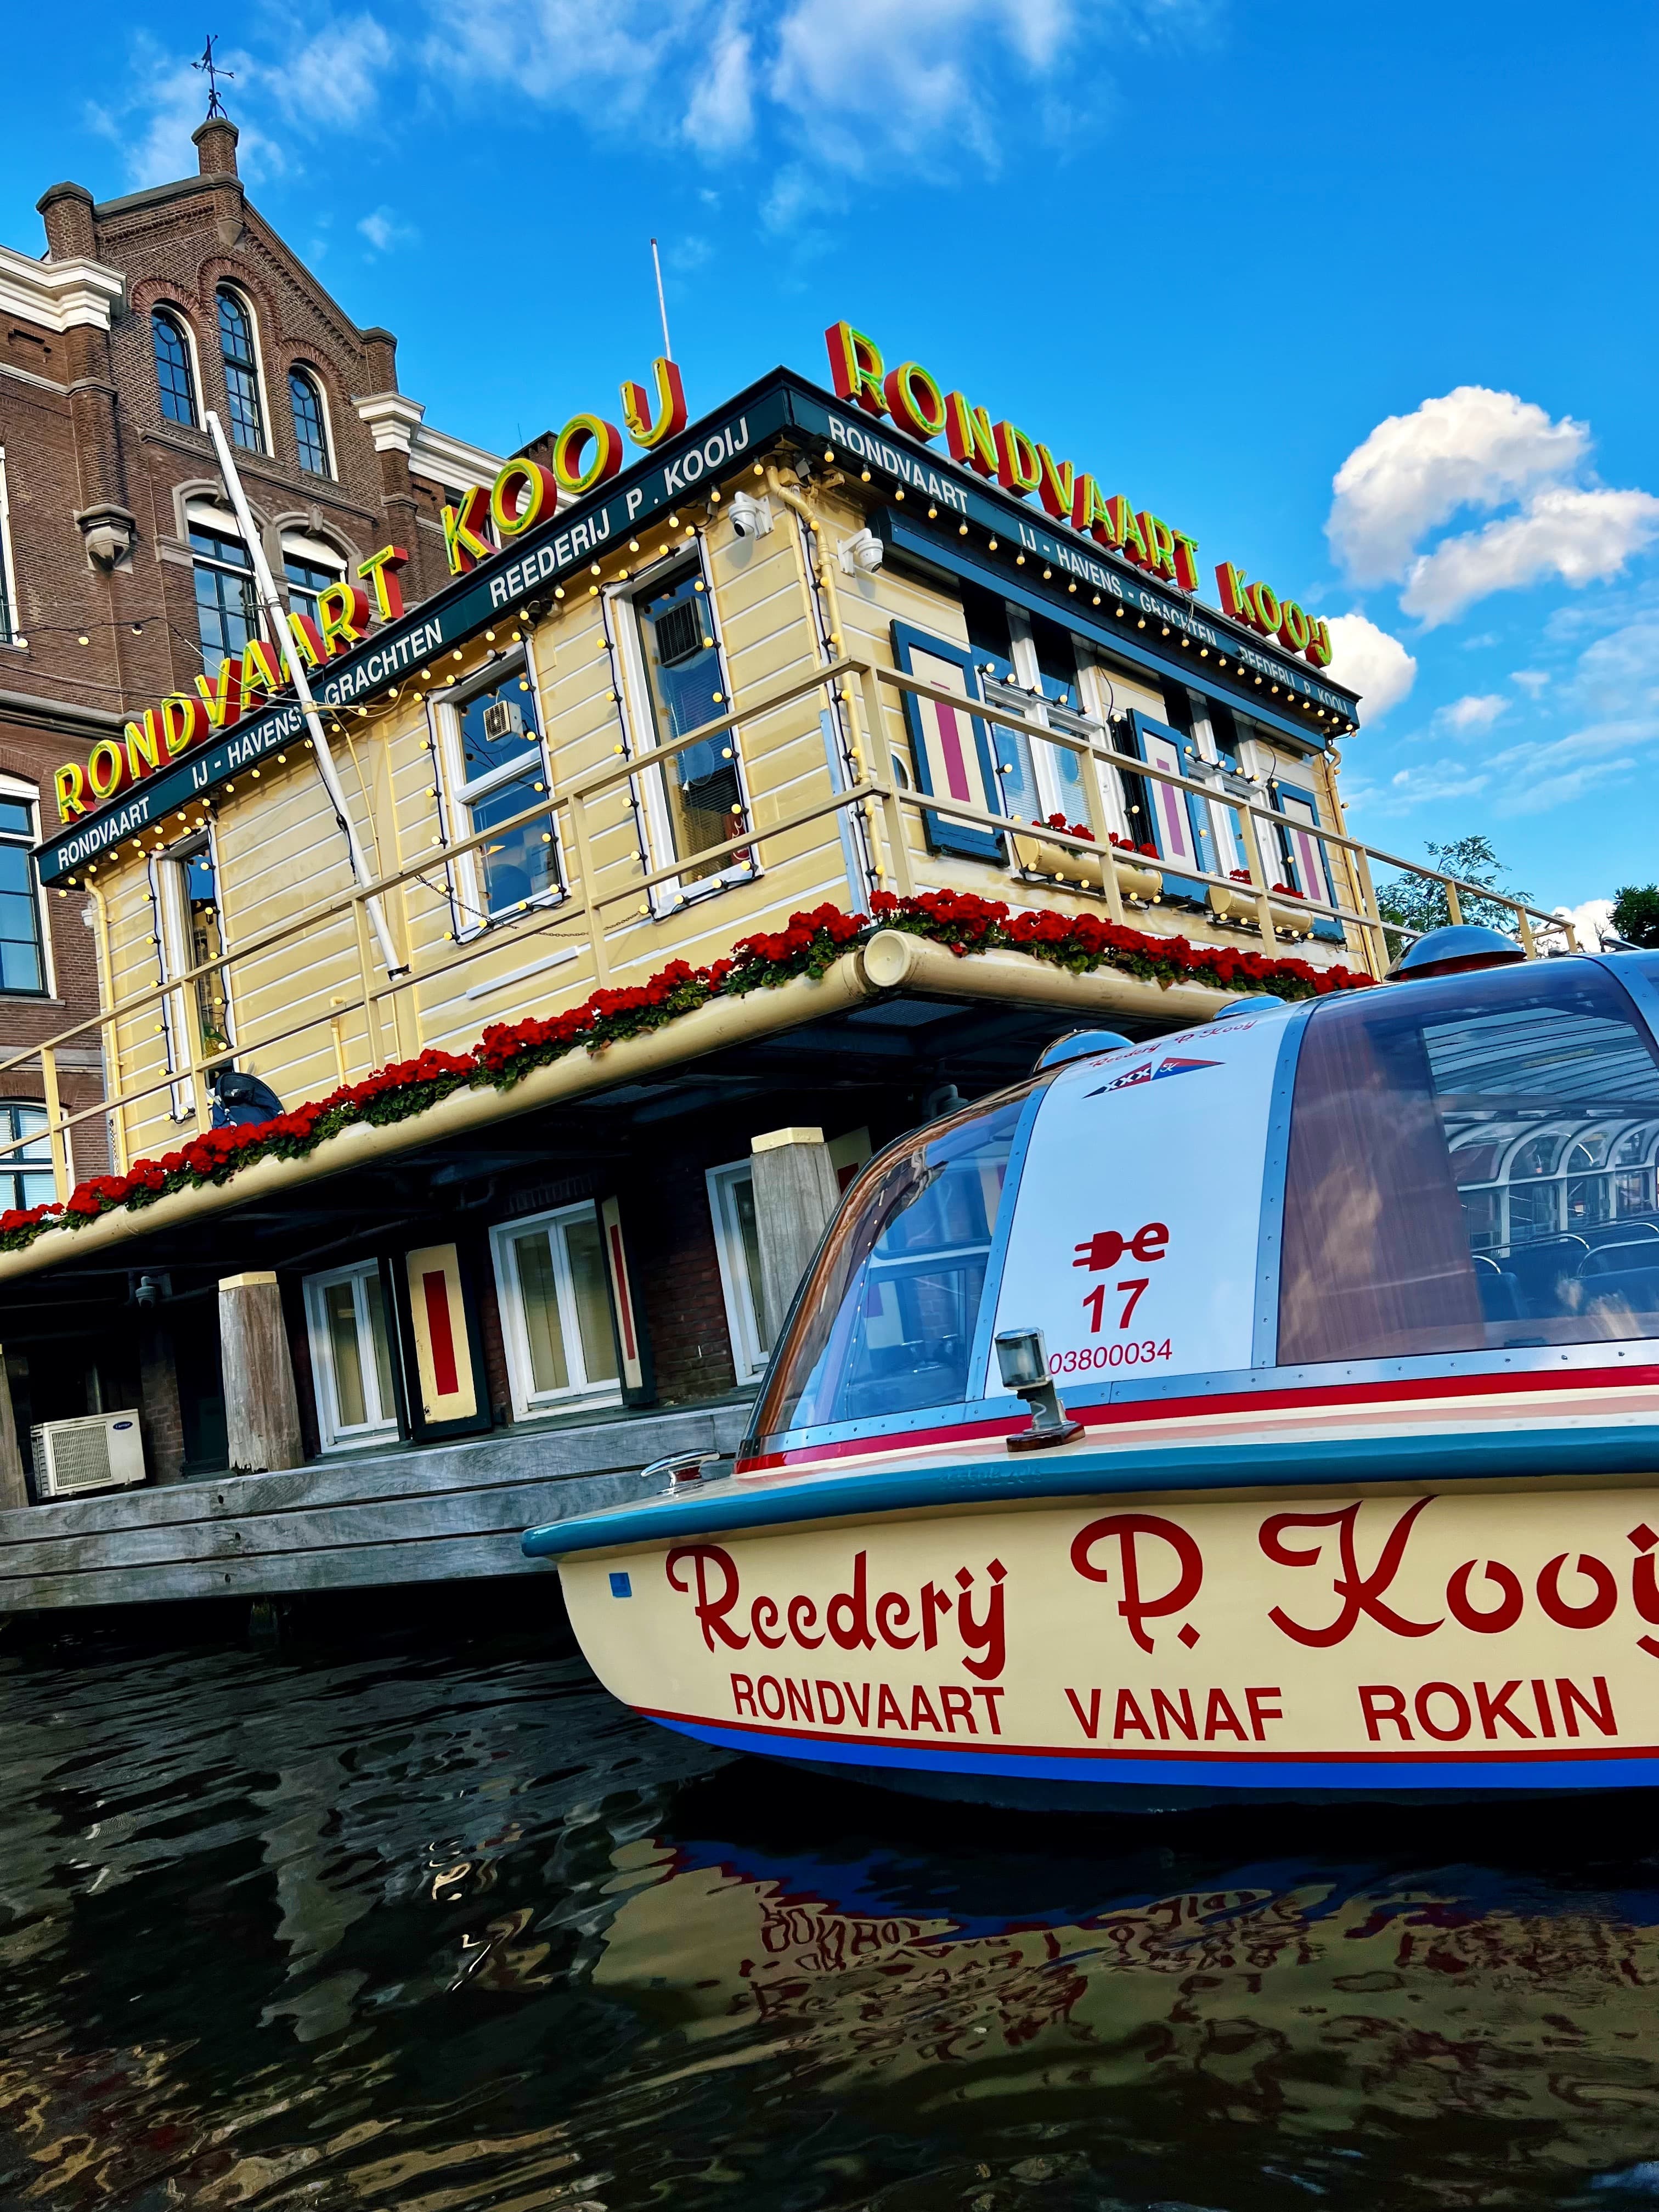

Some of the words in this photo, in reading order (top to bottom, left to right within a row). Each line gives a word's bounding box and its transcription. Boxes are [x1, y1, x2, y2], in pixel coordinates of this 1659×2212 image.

[825, 320, 1199, 591] RONDVAART
[828, 415, 967, 514] RONDVAART
[1019, 523, 1037, 552] IJ
[1056, 544, 1123, 598] HAVENS
[1139, 592, 1216, 646] GRACHTEN
[54, 544, 409, 824] RONDVAART
[58, 797, 150, 871] RONDVAART
[193, 760, 208, 789] IJ
[228, 706, 302, 769] HAVENS
[324, 618, 442, 706] GRACHTEN
[489, 510, 611, 608] REEDERIJ
[664, 417, 750, 496] KOOIJ
[1049, 1338, 1172, 1375] 03800034
[1082, 1278, 1149, 1333] 17
[665, 1544, 1006, 1680] Reederij
[1070, 1514, 1203, 1655] P.
[1258, 1494, 1659, 1659] Kooi
[730, 1673, 1005, 1735] RONDVAART
[1065, 1687, 1283, 1741] VANAF
[1358, 1676, 1618, 1742] ROKIN
